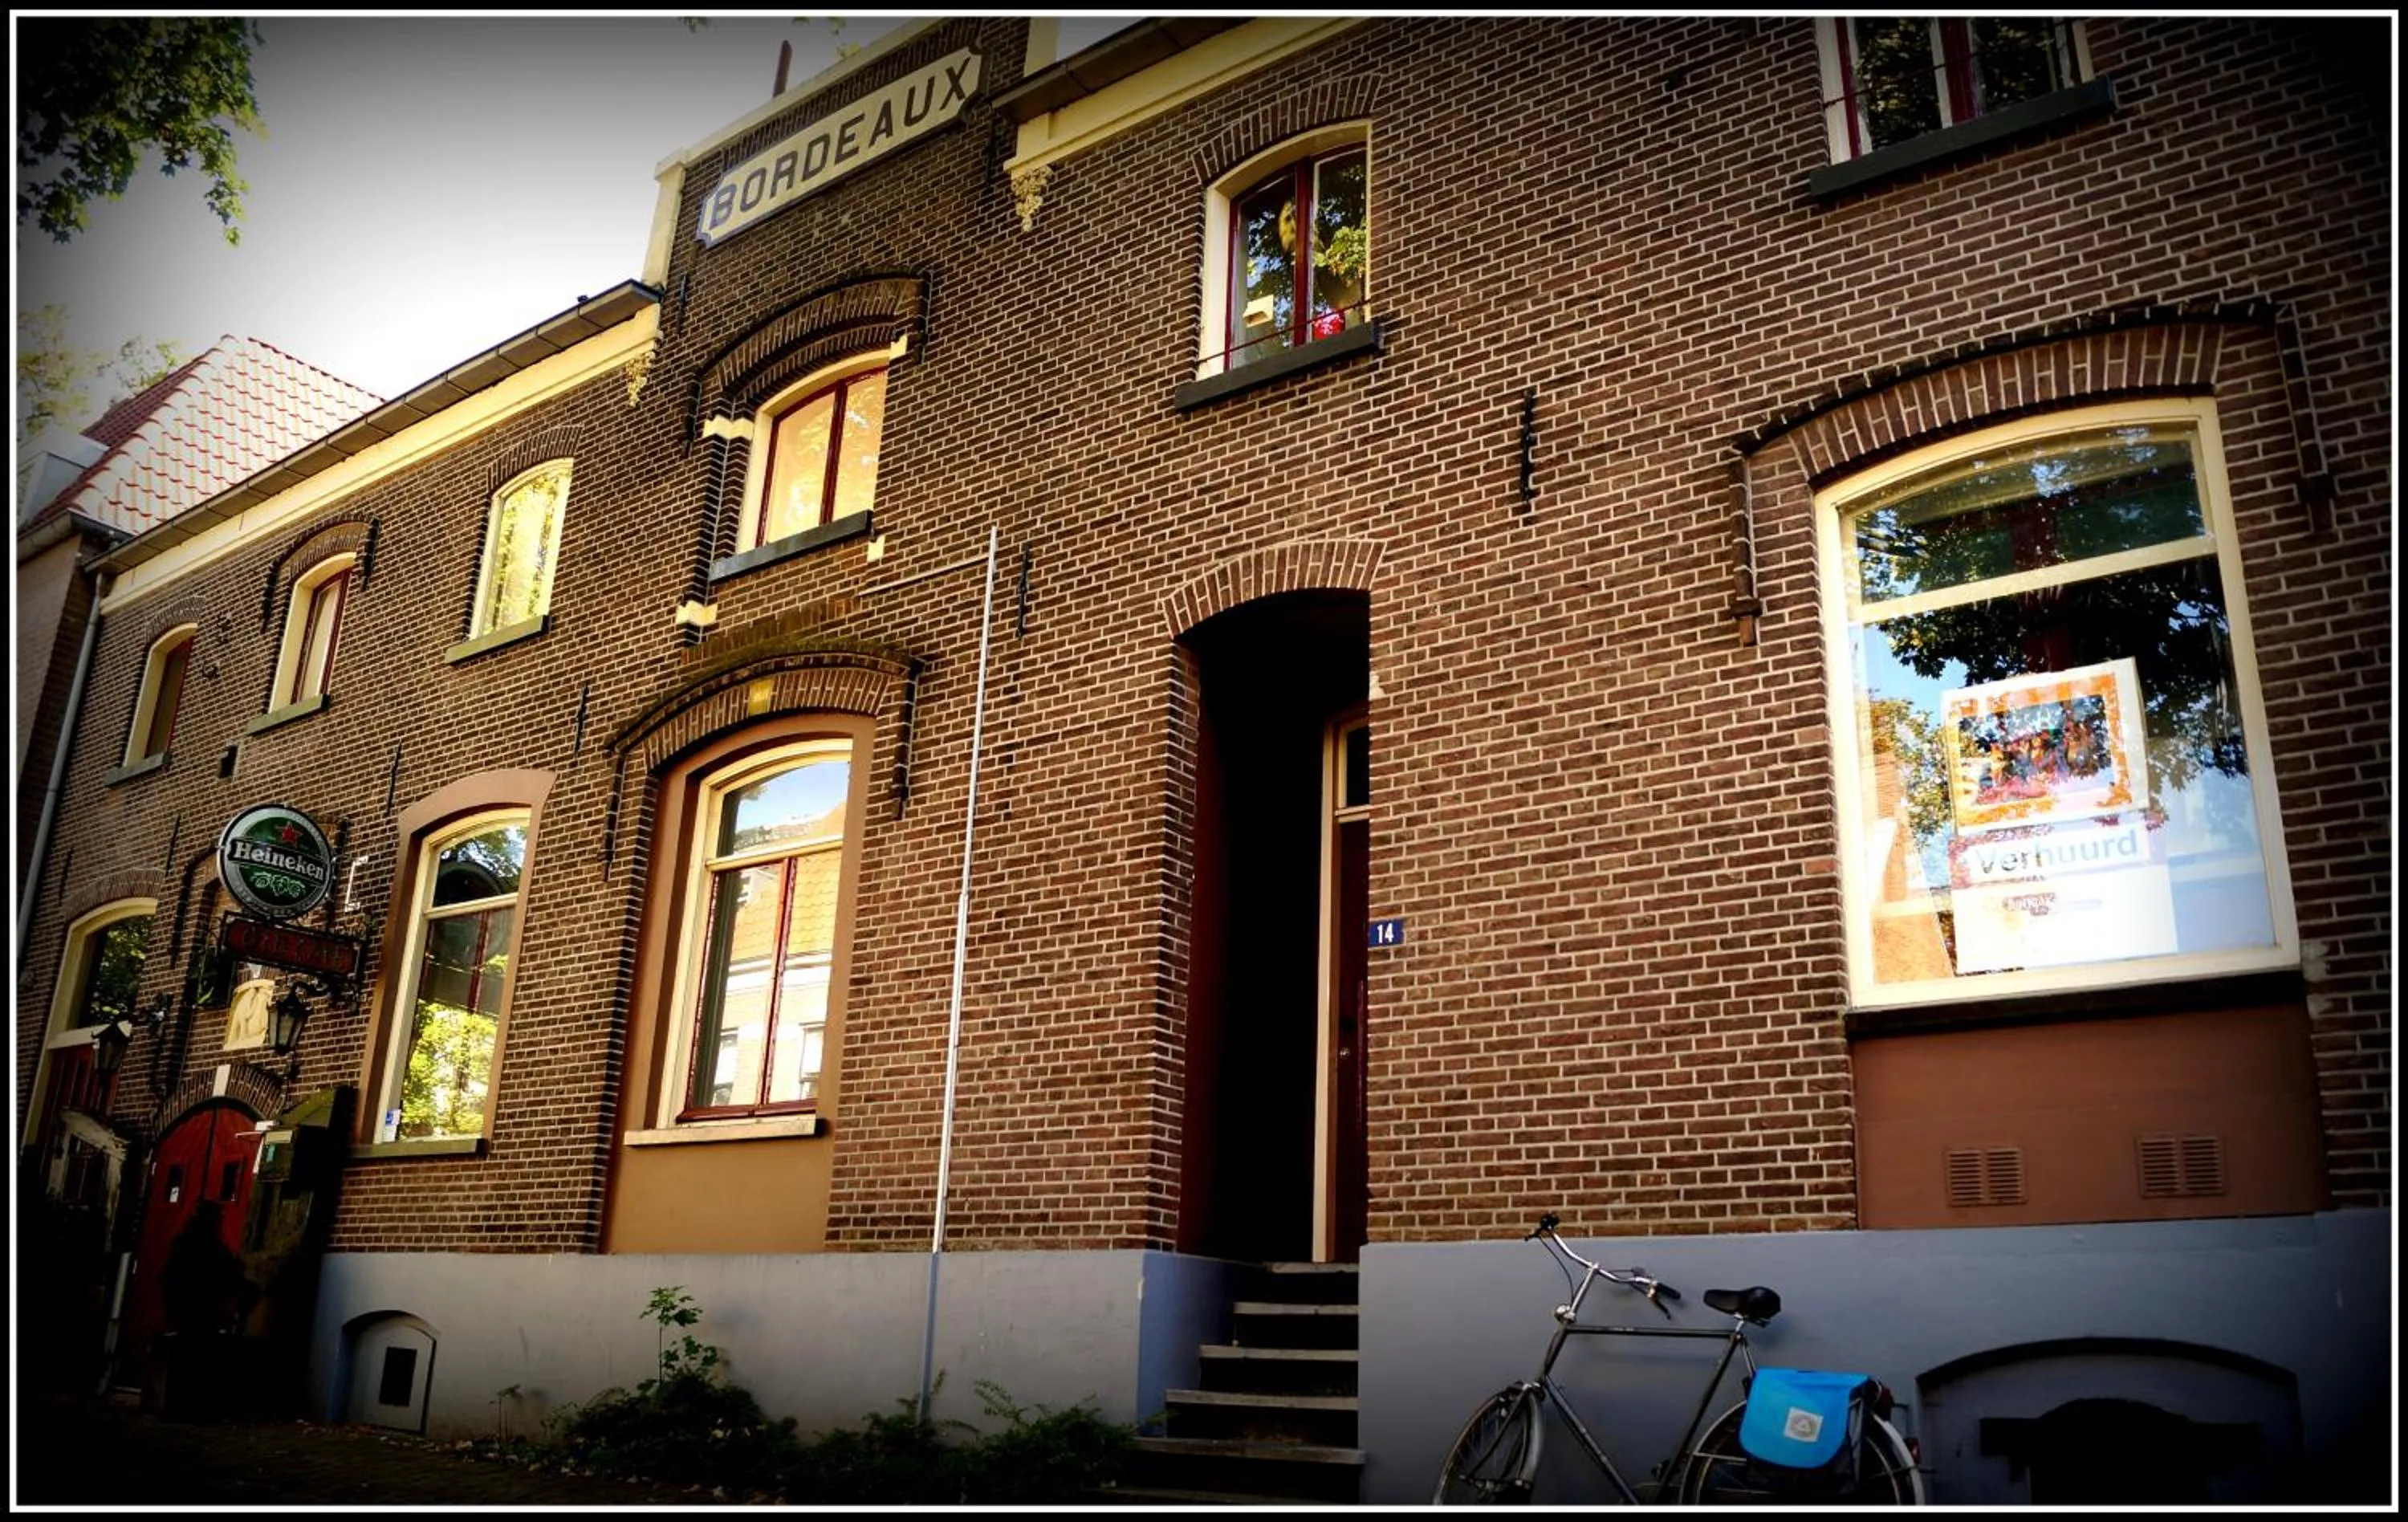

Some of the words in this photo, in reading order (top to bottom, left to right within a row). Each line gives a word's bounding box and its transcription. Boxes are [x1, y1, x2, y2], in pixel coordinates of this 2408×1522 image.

[709, 56, 970, 230] BORDEAUX
[233, 840, 324, 881] Heineken
[1975, 828, 2138, 874] Verhuurd
[1377, 922, 1394, 944] 14
